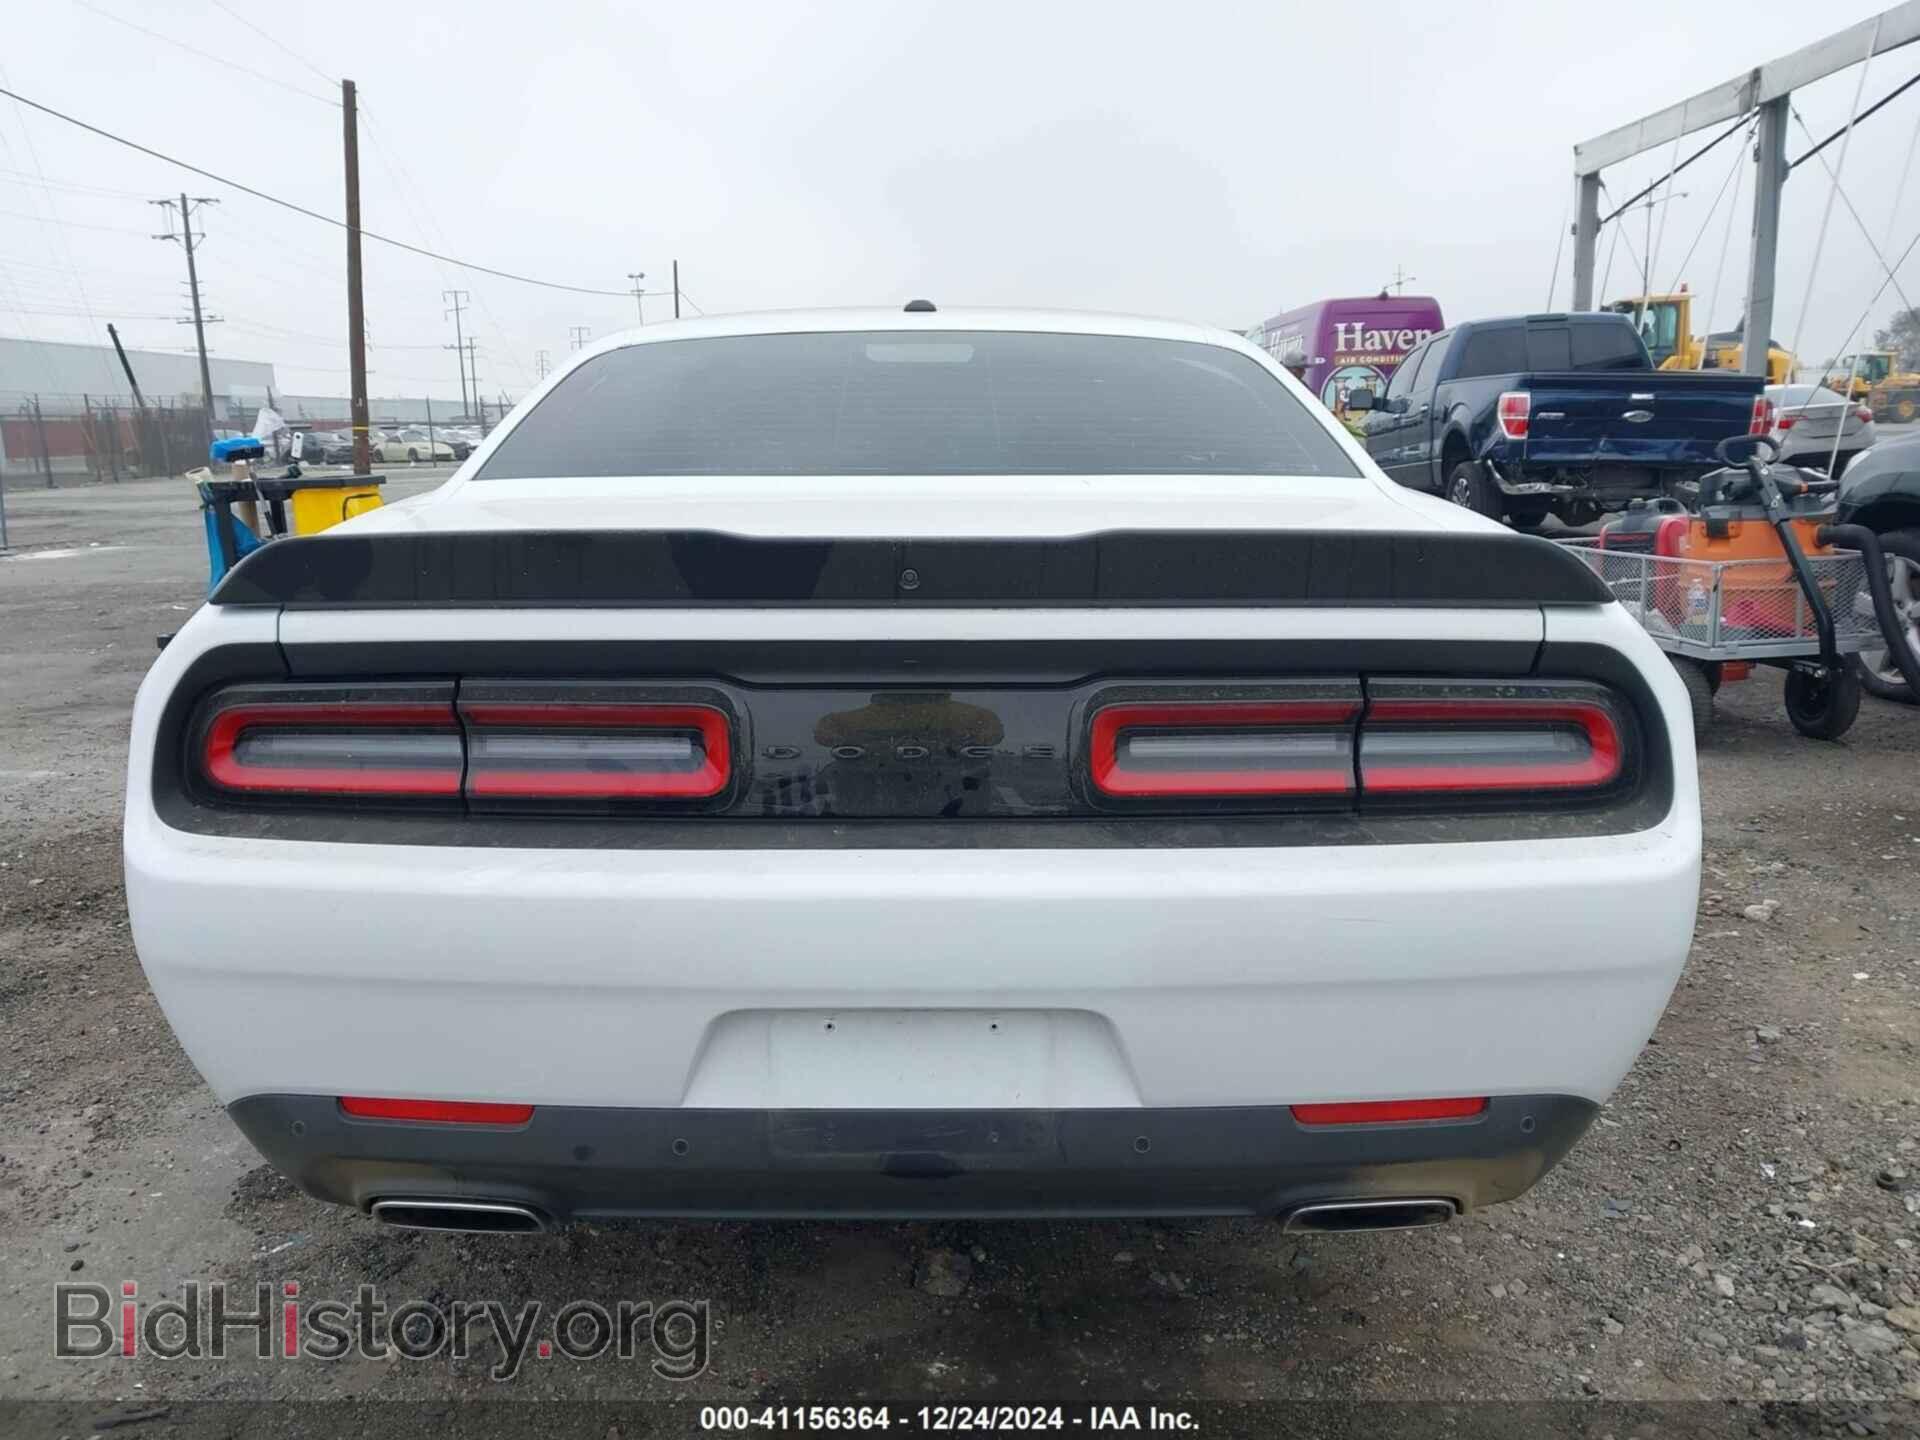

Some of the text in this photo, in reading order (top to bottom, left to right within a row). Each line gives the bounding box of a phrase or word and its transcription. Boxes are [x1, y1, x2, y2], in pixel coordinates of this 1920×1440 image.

[1334, 322, 1433, 352] Haven
[1340, 356, 1357, 364] AIR
[763, 744, 1055, 760] DODGE
